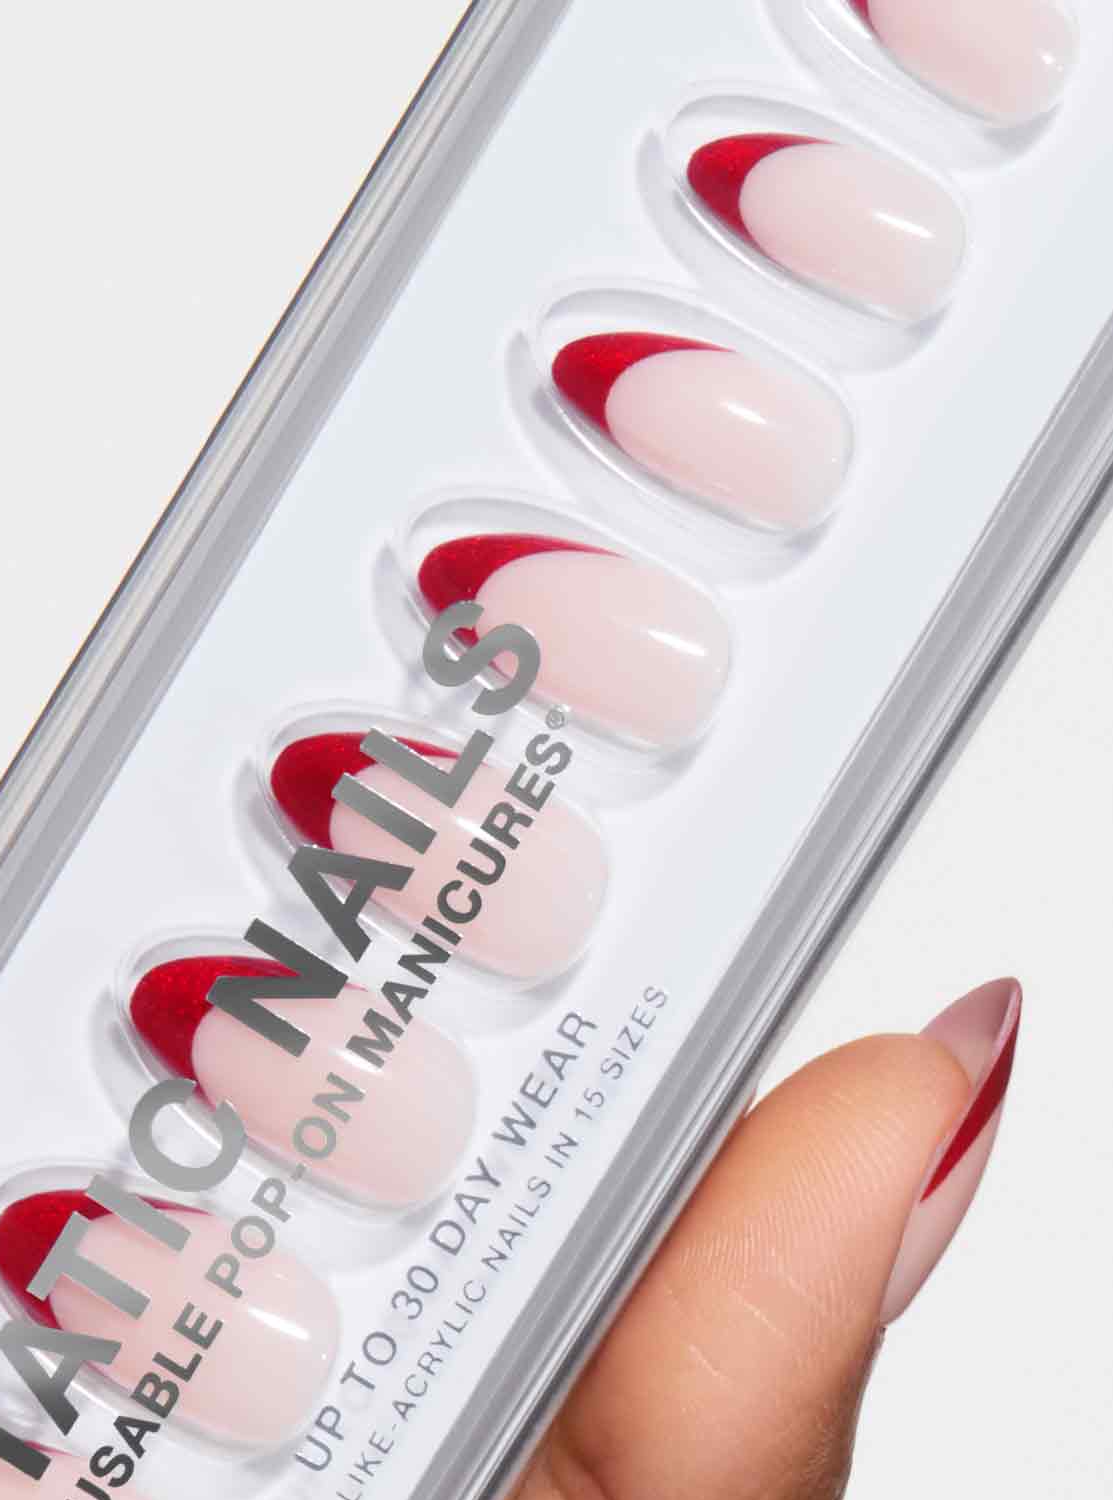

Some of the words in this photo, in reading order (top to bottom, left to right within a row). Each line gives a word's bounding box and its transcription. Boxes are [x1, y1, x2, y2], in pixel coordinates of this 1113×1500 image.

[208, 600, 540, 1057] NAILS
[204, 1075, 367, 1298] POP-ON
[295, 1405, 344, 1471] UP
[340, 1331, 396, 1390] TO
[391, 1265, 438, 1320] 30
[429, 1156, 501, 1256] DAY
[492, 1011, 598, 1146] WEAR
[481, 1176, 551, 1271] NAILS
[544, 1132, 578, 1168] IN
[575, 1088, 604, 1120] 15
[600, 986, 667, 1080] SIZES
